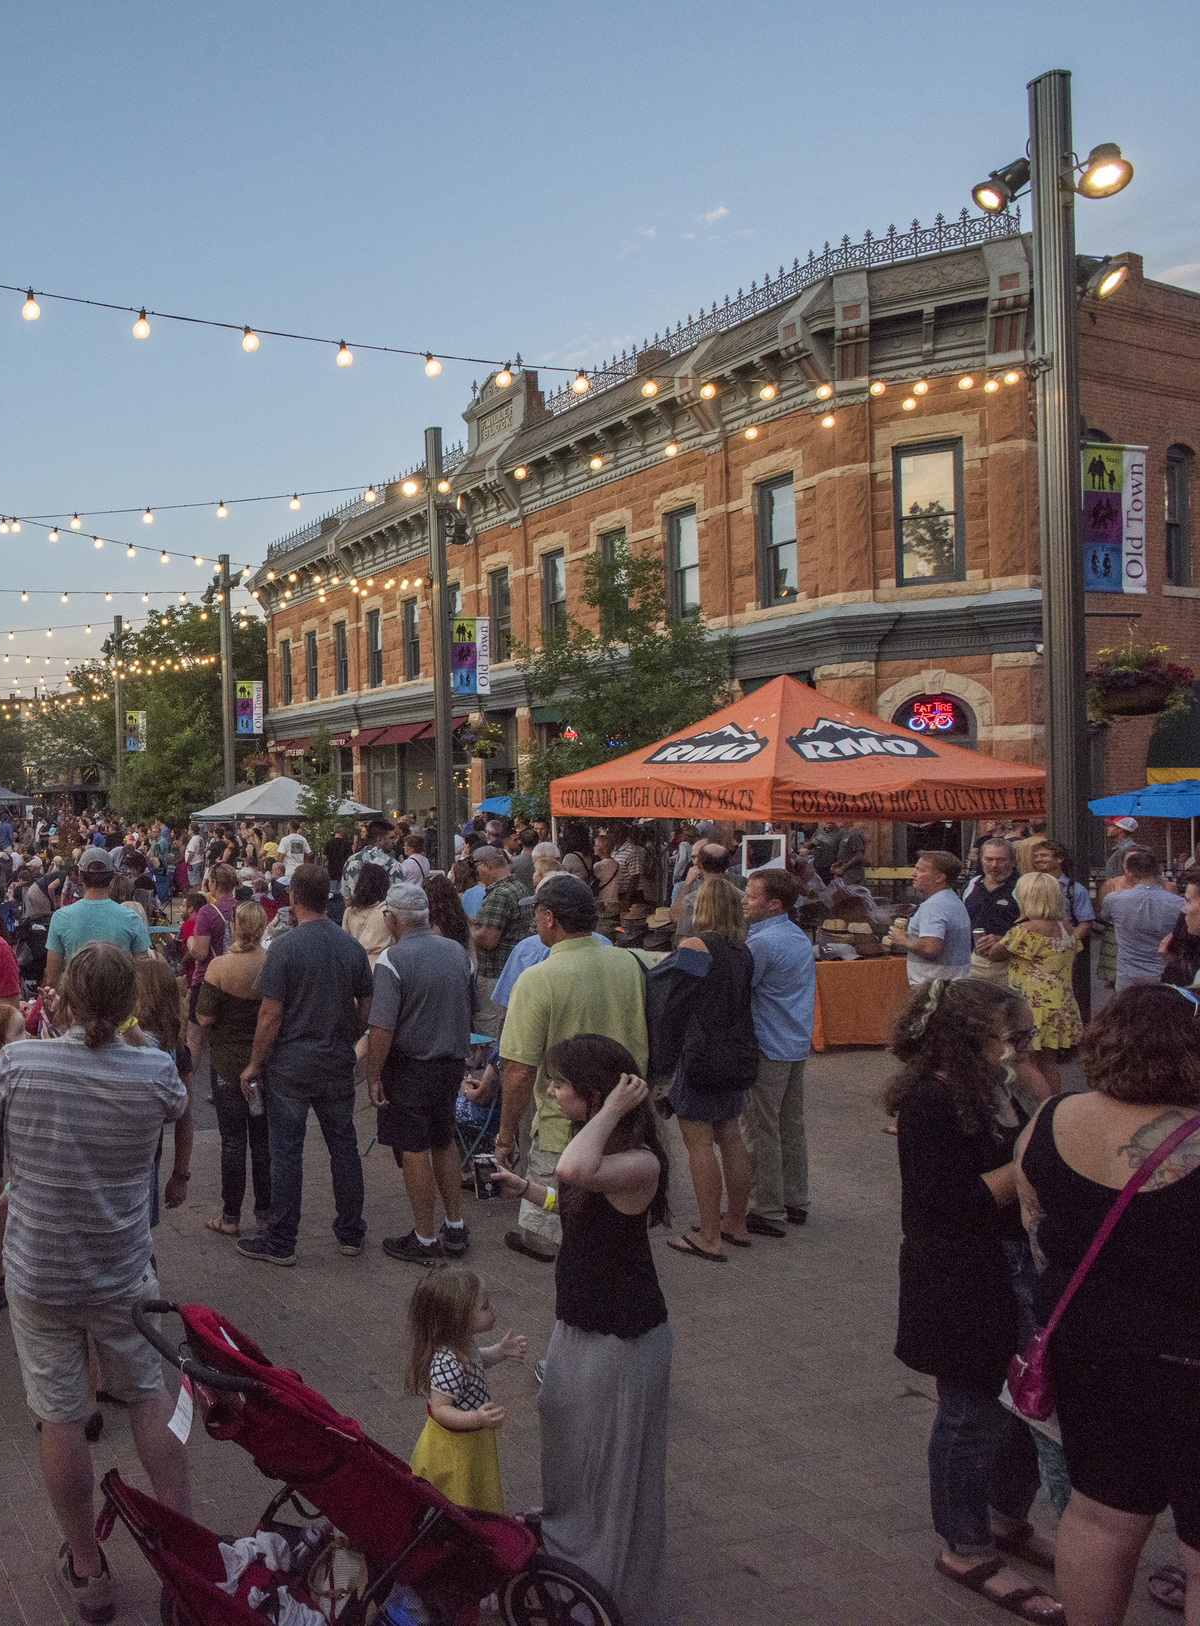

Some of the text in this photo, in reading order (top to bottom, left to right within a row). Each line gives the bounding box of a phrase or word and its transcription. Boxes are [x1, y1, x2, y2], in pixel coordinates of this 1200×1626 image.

[484, 417, 513, 440] BLOCK
[1125, 463, 1144, 579] Old Town
[478, 626, 489, 687] Old Town
[254, 687, 262, 729] Old Town
[913, 701, 953, 713] FAT TIRE
[650, 741, 762, 764] RMO
[797, 736, 920, 760] RMO
[560, 786, 755, 811] COLORADO HIGH COUNTRY HATS
[790, 786, 1046, 813] COLORADO HIGH COUNTRY HAT
